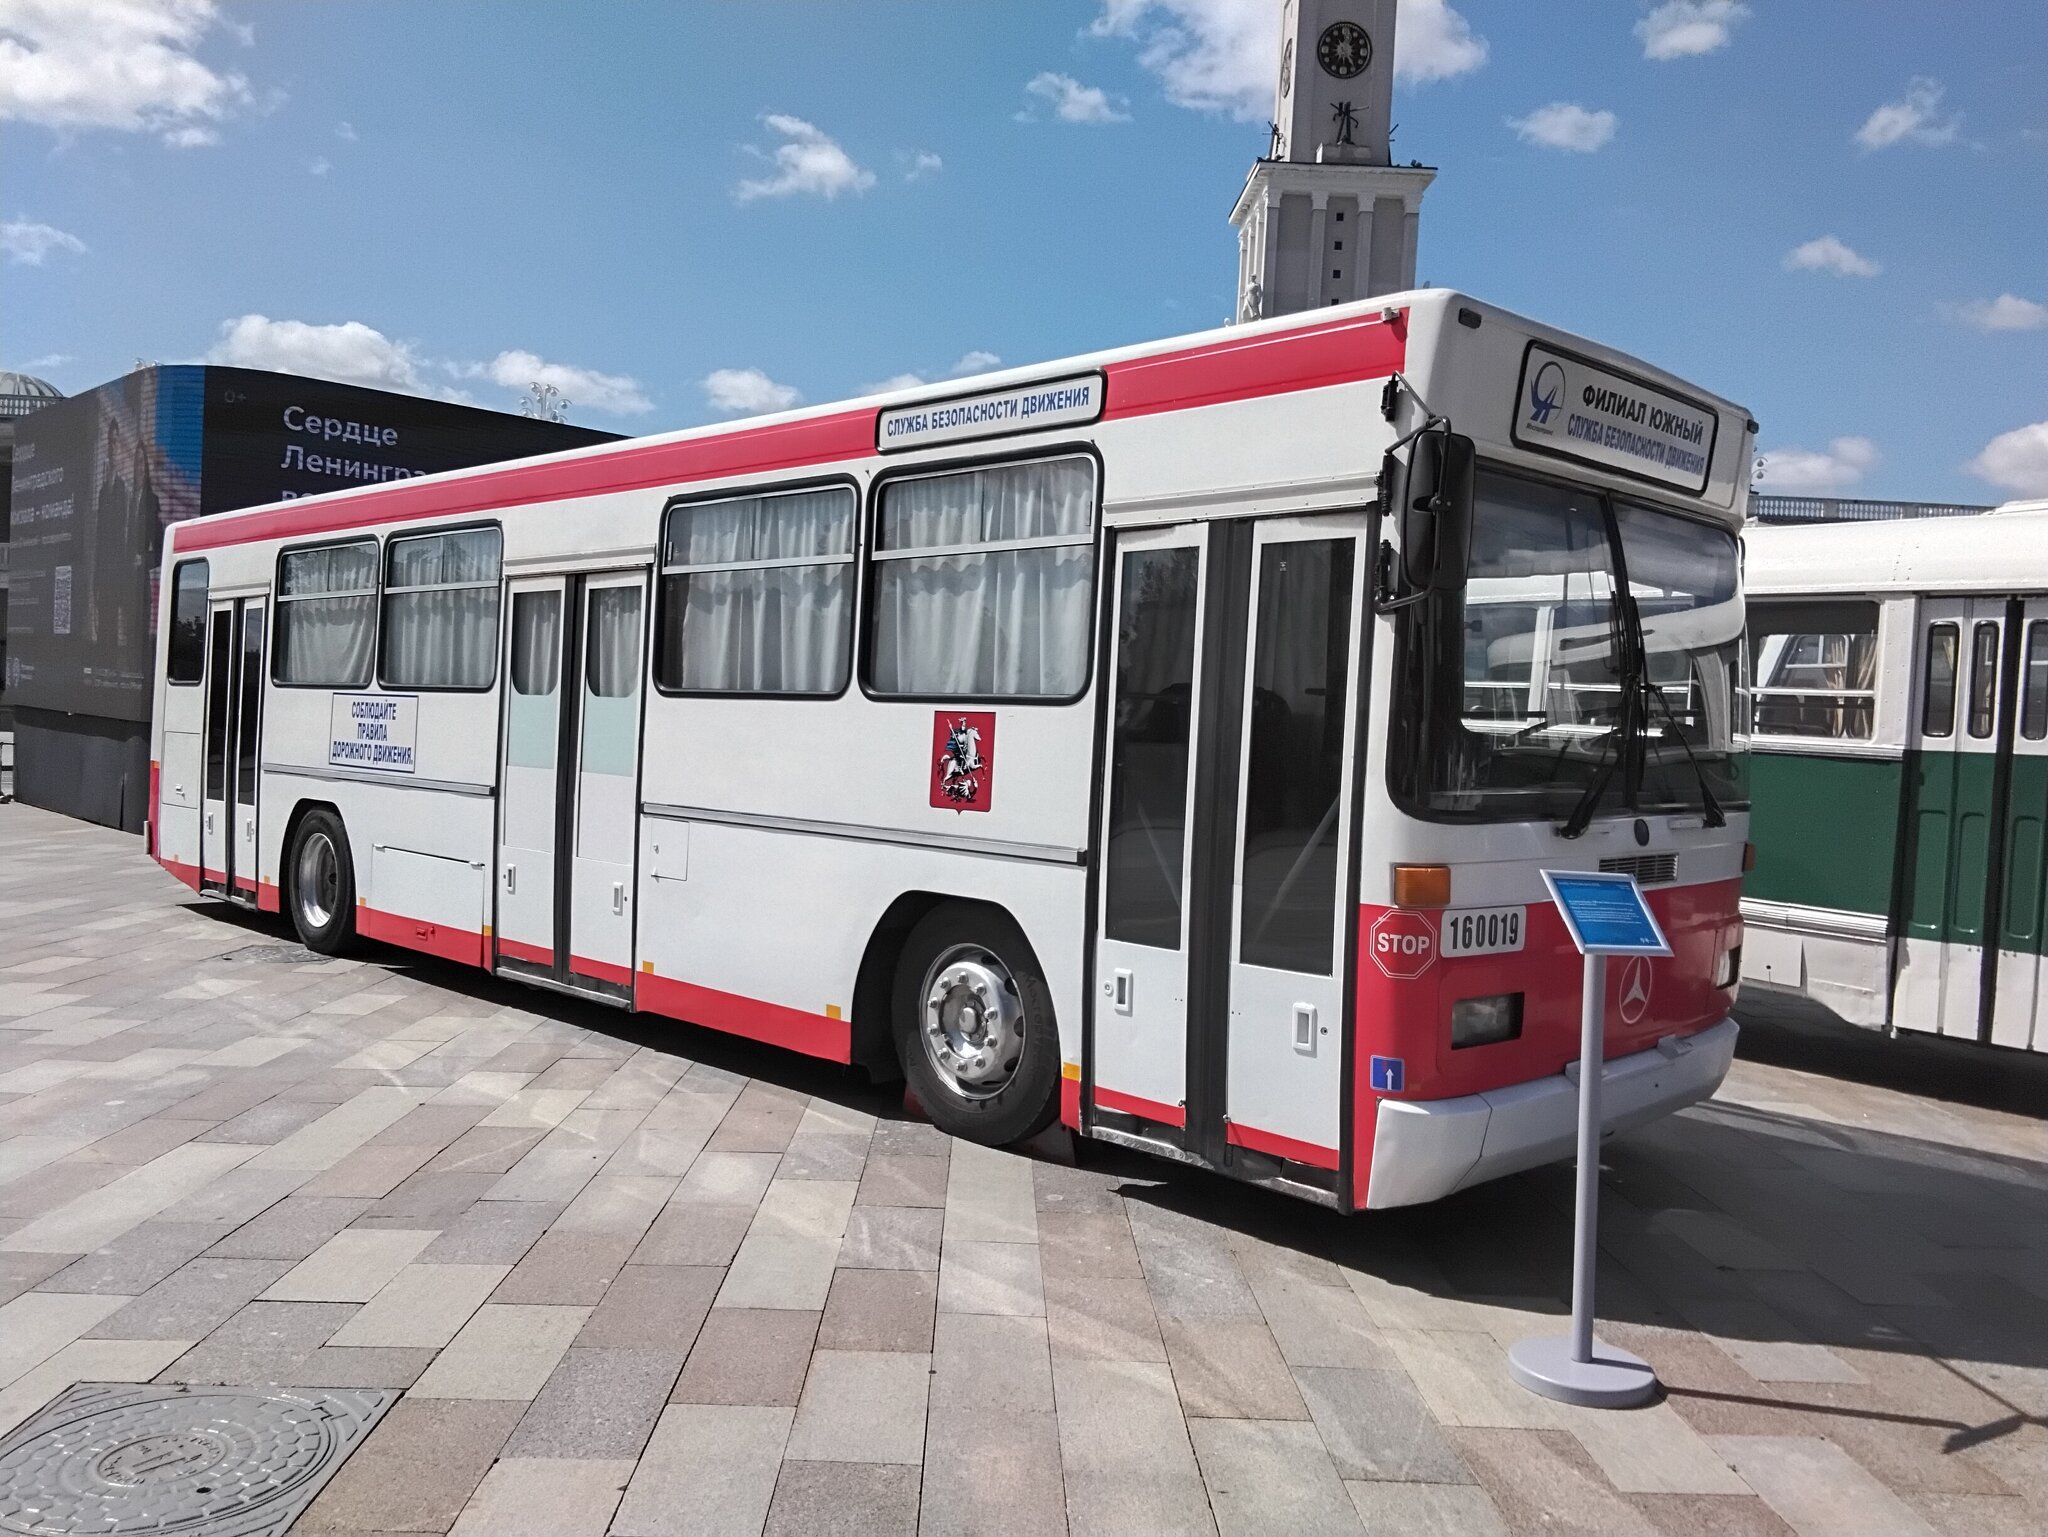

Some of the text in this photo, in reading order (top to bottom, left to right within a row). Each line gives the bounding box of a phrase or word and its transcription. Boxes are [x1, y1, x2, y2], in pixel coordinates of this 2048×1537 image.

[283, 405, 399, 448] Сердце
[887, 386, 1090, 438] СЛУЖБА БЕЗОПАСНОСТИ ДВИЖЕНИЯ
[1582, 385, 1703, 446] ФИЛИАЛ ЮЖНЫЙ
[1568, 413, 1603, 446] СЛУЖБА
[1604, 425, 1667, 465] БЕЗОПАСНОСТИ
[1665, 445, 1705, 477] ДВИЖЕНИЯ
[352, 700, 397, 722] СОБЛЮДАЙТЕ
[332, 740, 372, 761] ДОРОЖНОГО
[357, 722, 388, 742] ПРАВИЛА
[1377, 932, 1430, 955] STOP
[1450, 912, 1519, 950] 160019
